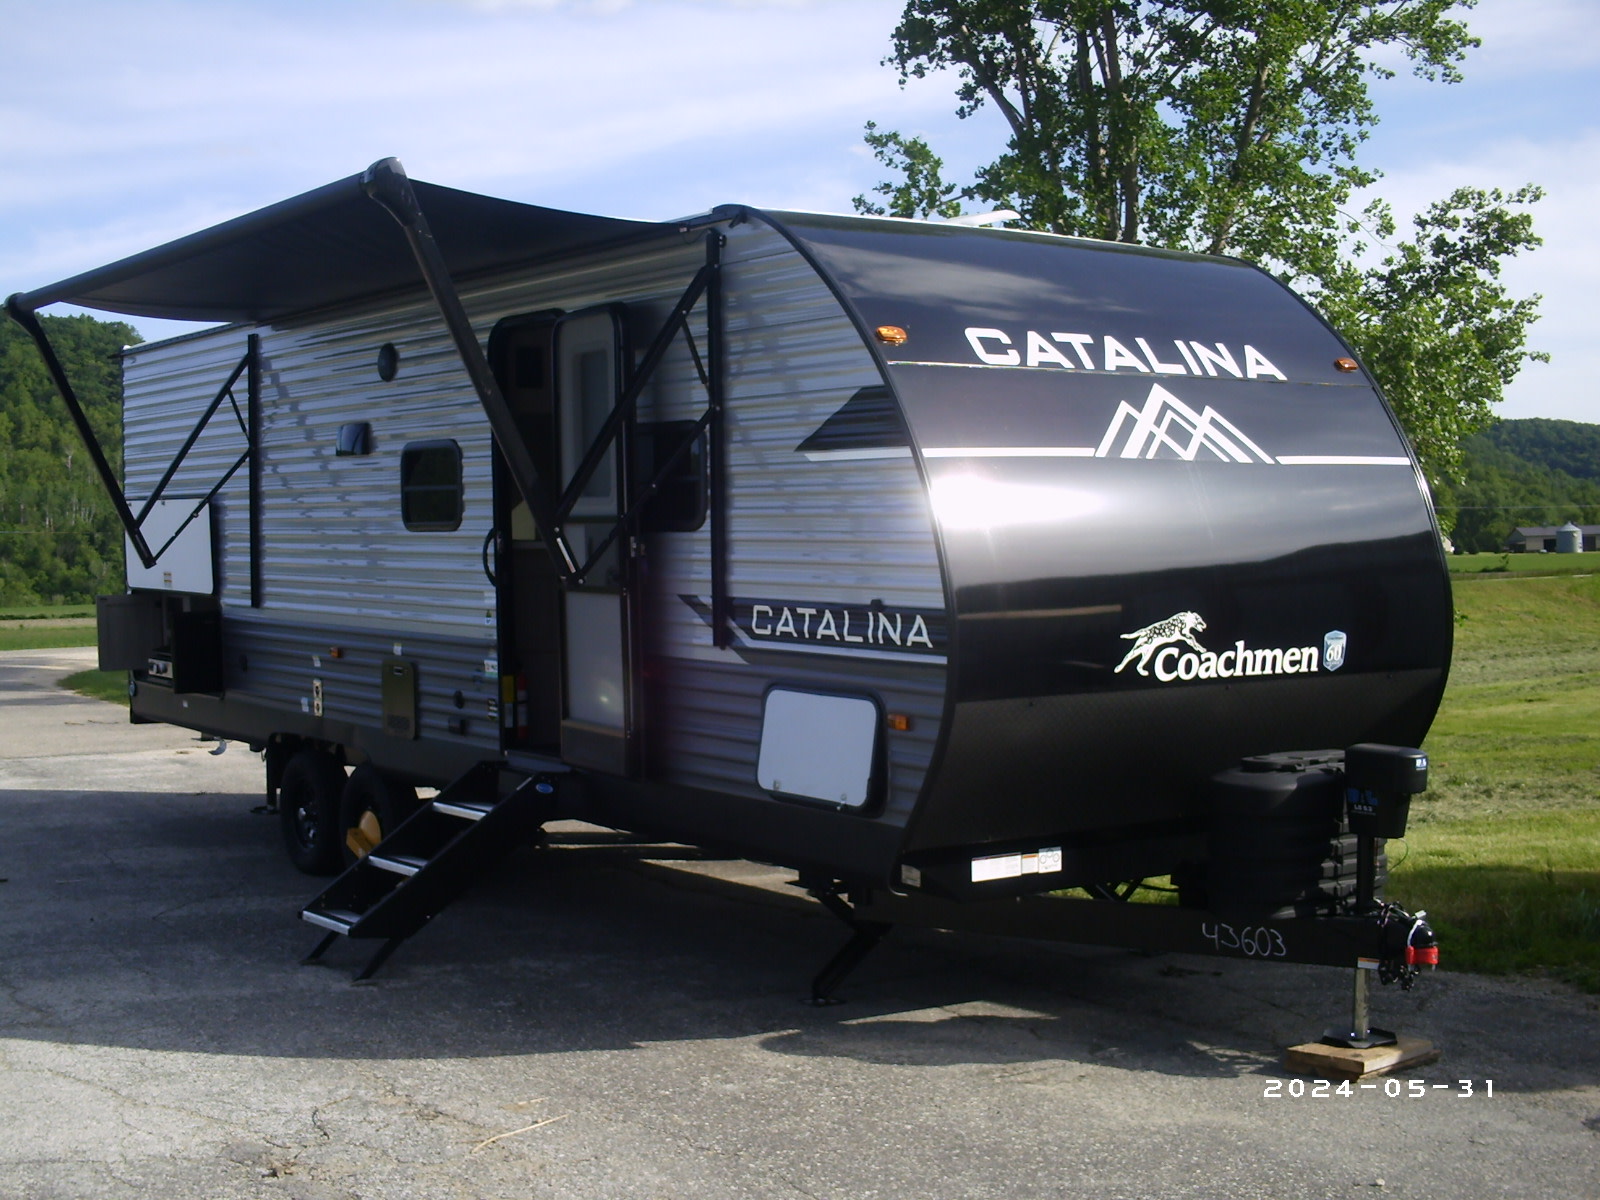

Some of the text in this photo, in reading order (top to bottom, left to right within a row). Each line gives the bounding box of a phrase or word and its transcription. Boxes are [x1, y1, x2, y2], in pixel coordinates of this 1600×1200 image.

[963, 327, 1289, 382] CATALINA
[751, 604, 934, 649] CATALINA
[1153, 639, 1319, 683] Coachmen
[1325, 644, 1342, 662] 60
[1201, 922, 1287, 957] 43603
